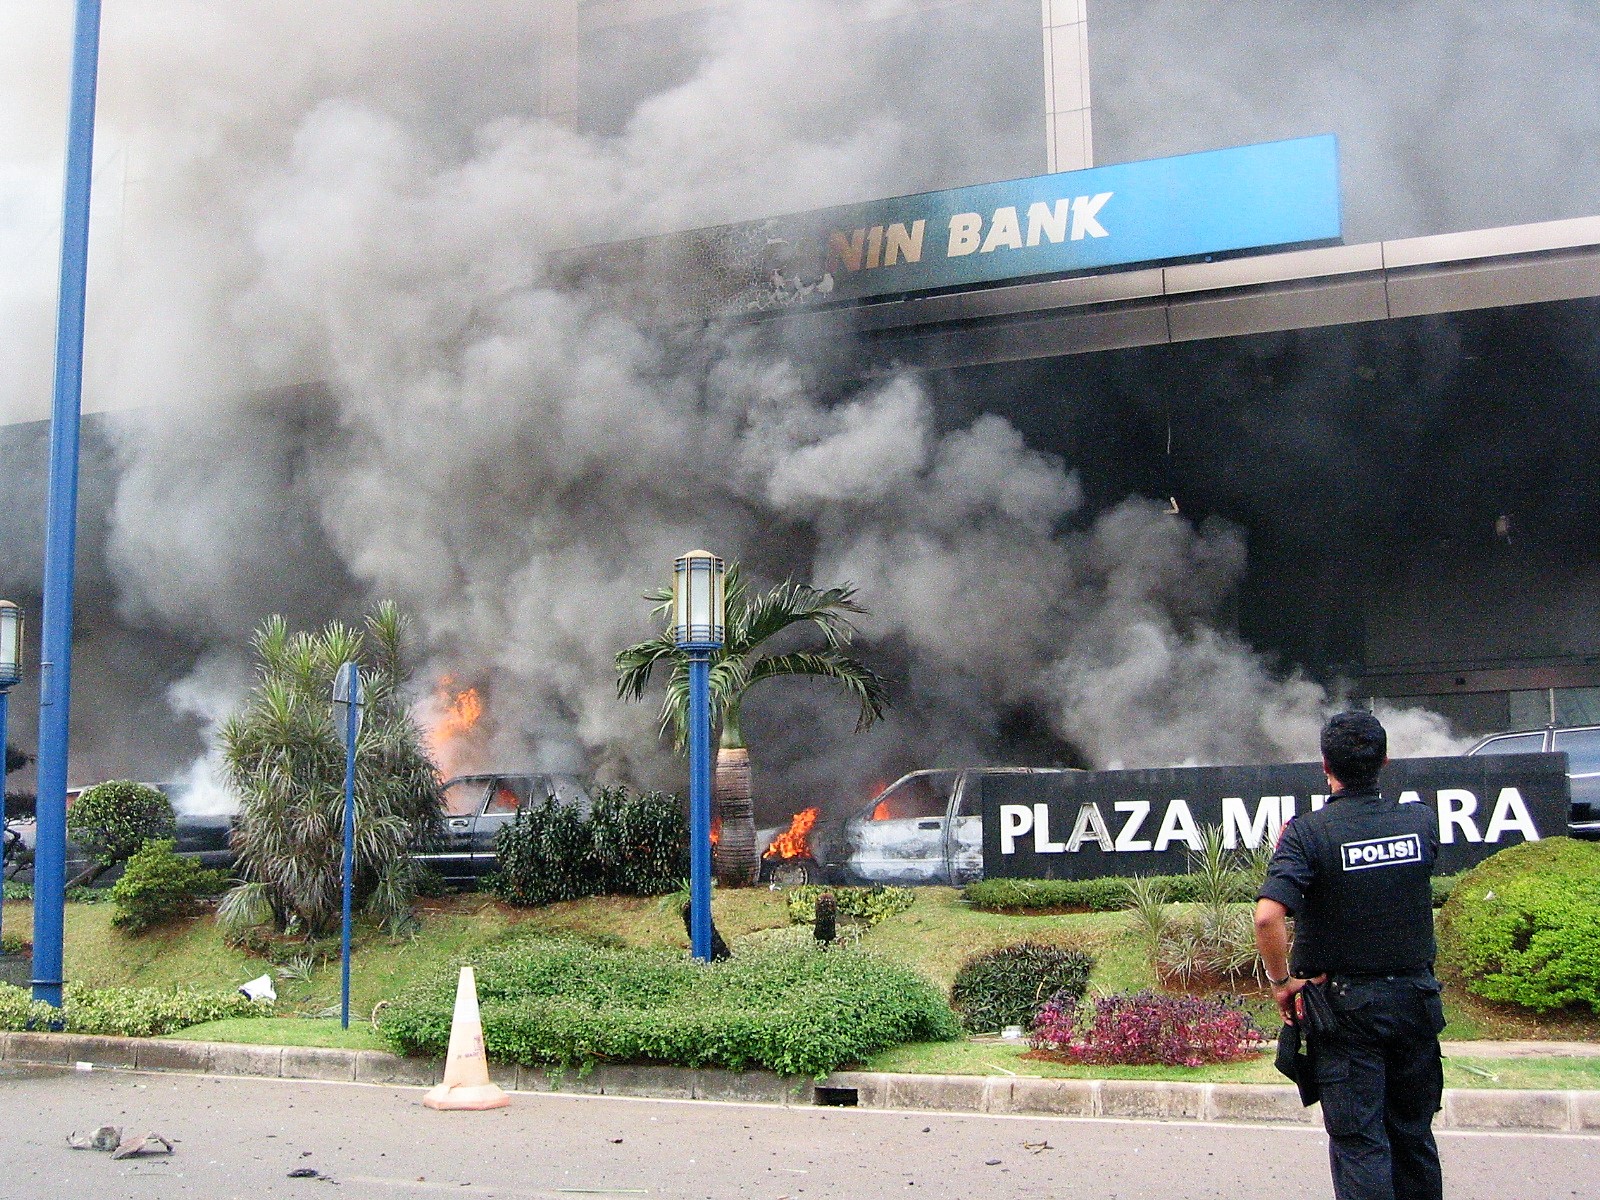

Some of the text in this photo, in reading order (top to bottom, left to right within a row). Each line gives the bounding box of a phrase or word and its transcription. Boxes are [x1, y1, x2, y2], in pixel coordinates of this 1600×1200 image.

[947, 192, 1114, 257] BANK
[1000, 799, 1203, 854] PLAZA
[1348, 840, 1414, 864] POLISI
